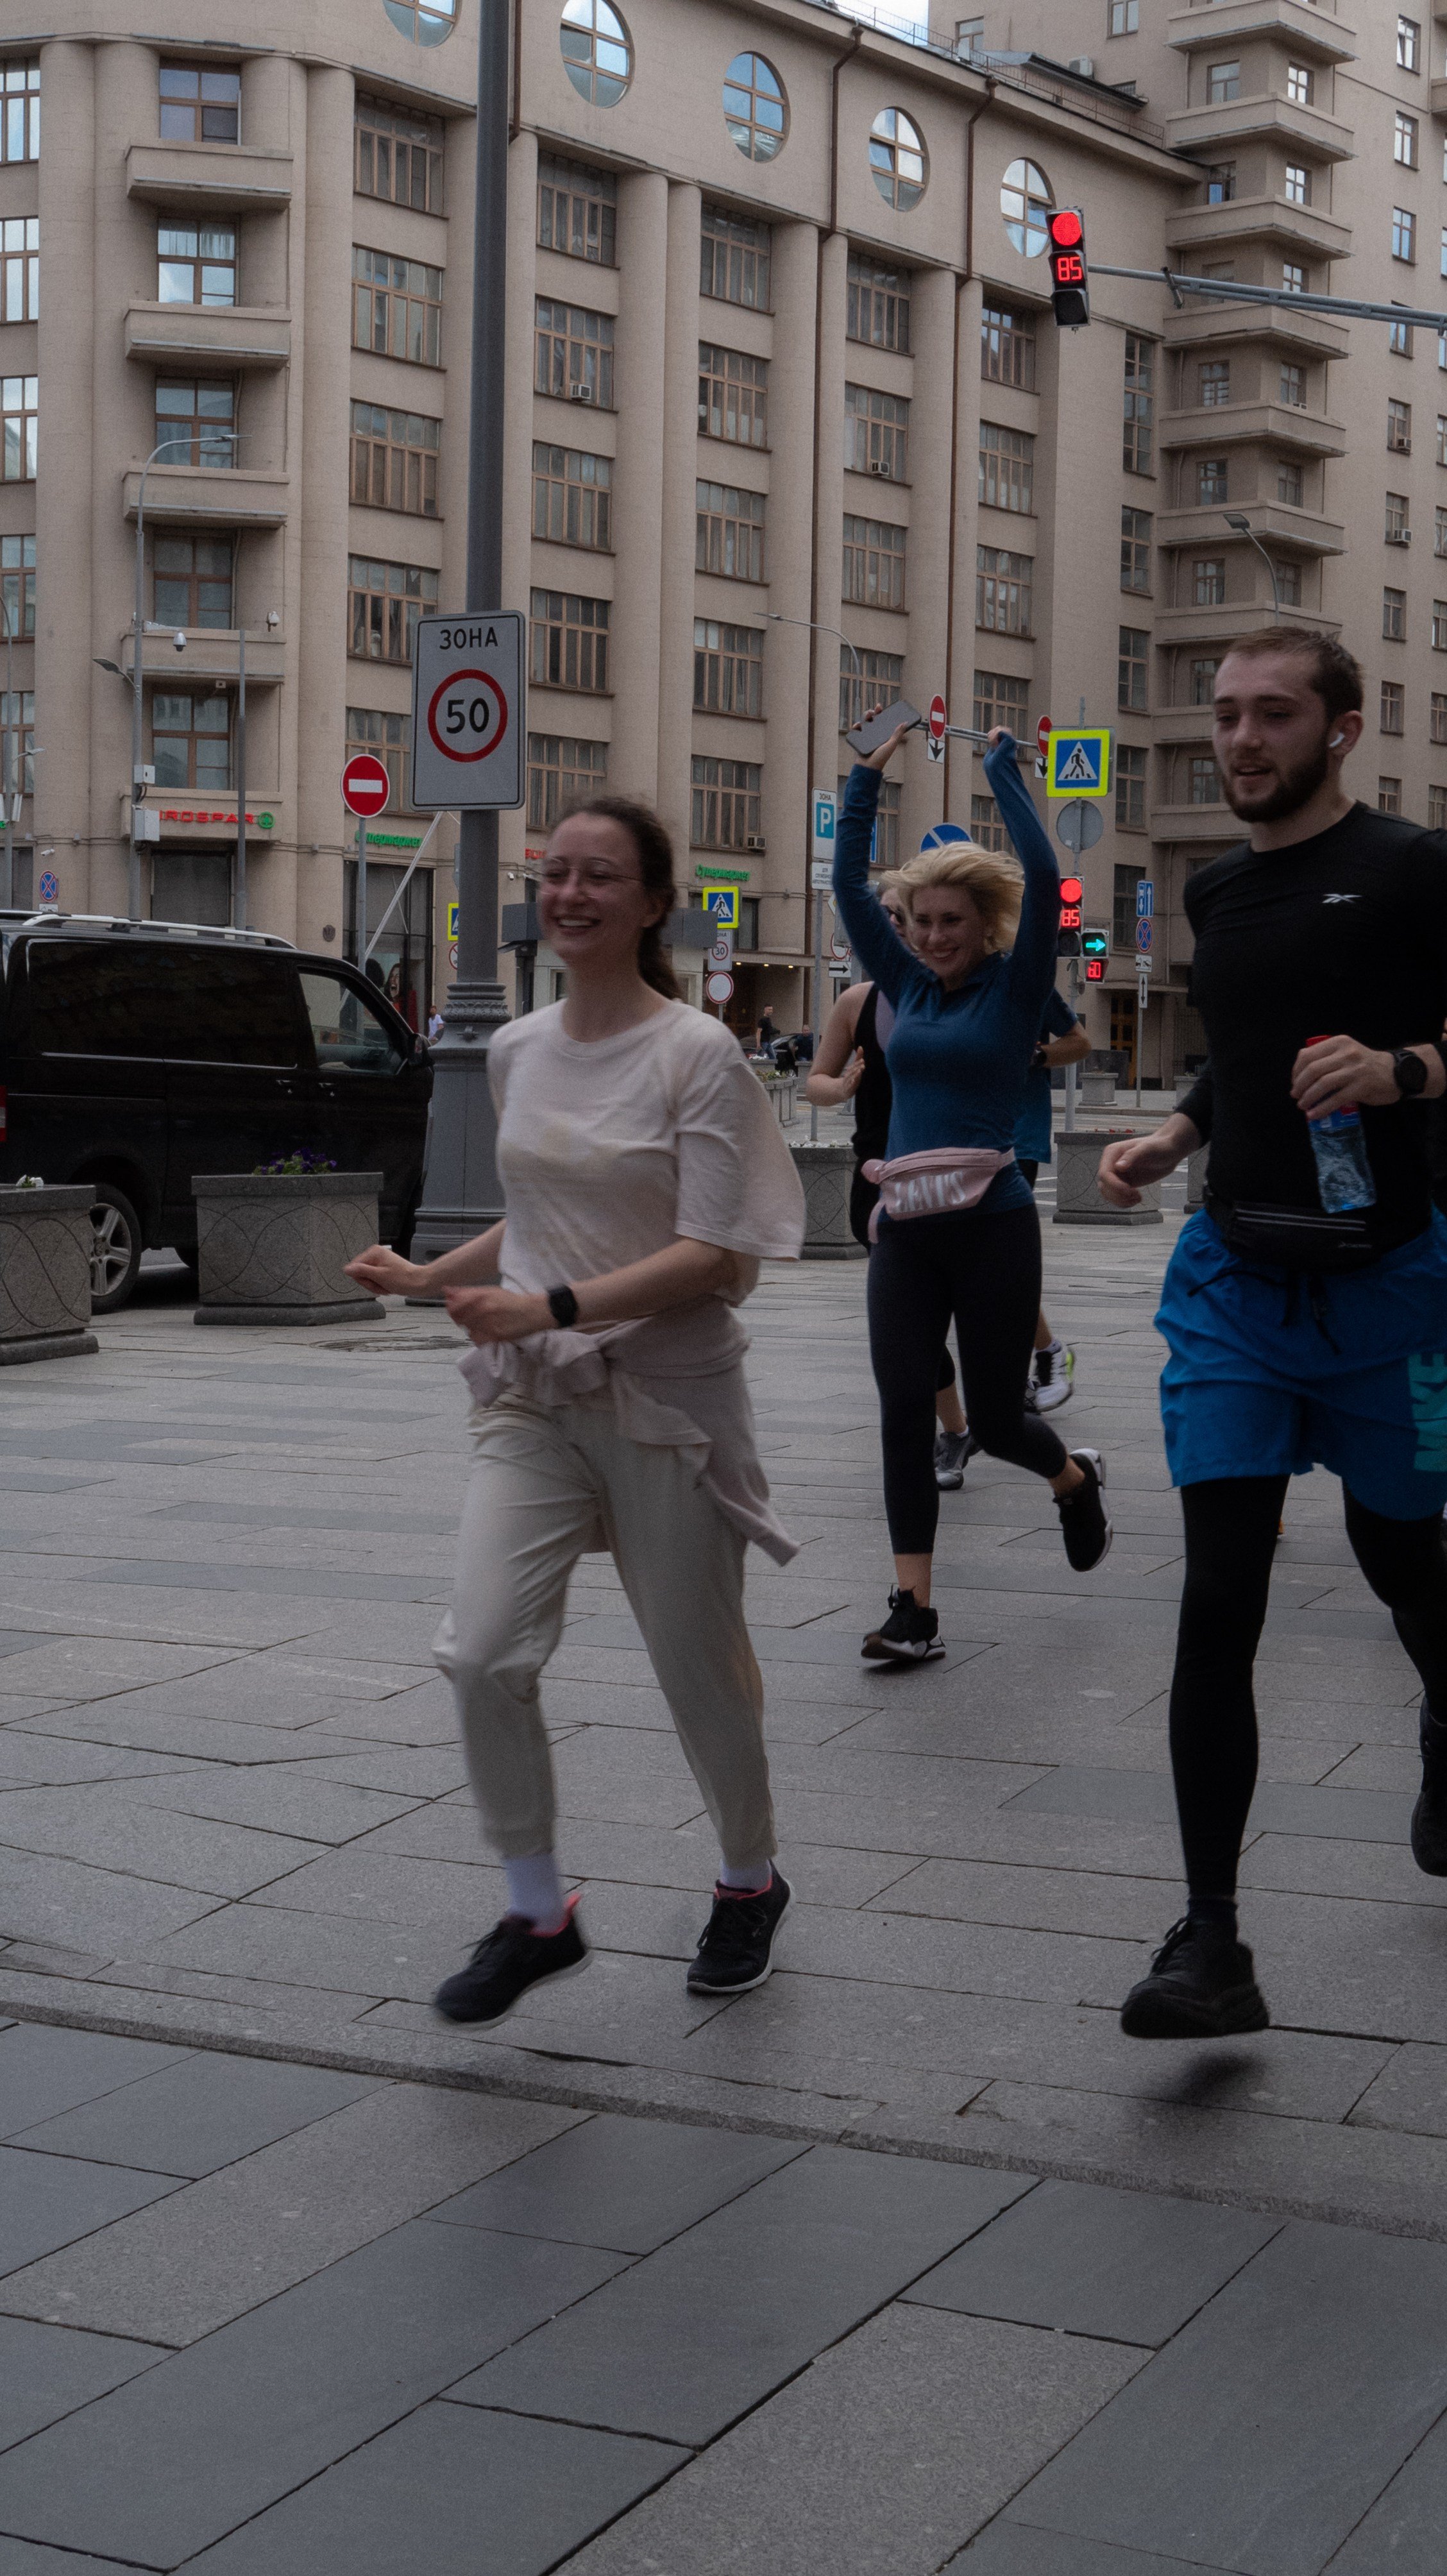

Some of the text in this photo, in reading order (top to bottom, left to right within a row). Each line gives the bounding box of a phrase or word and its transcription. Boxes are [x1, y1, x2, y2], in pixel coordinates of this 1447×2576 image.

[1057, 256, 1082, 281] 85
[439, 627, 498, 650] ЗОНА
[446, 697, 490, 733] 50
[160, 809, 254, 824] ROSPAR
[1062, 909, 1079, 926] 85
[716, 947, 725, 955] 30
